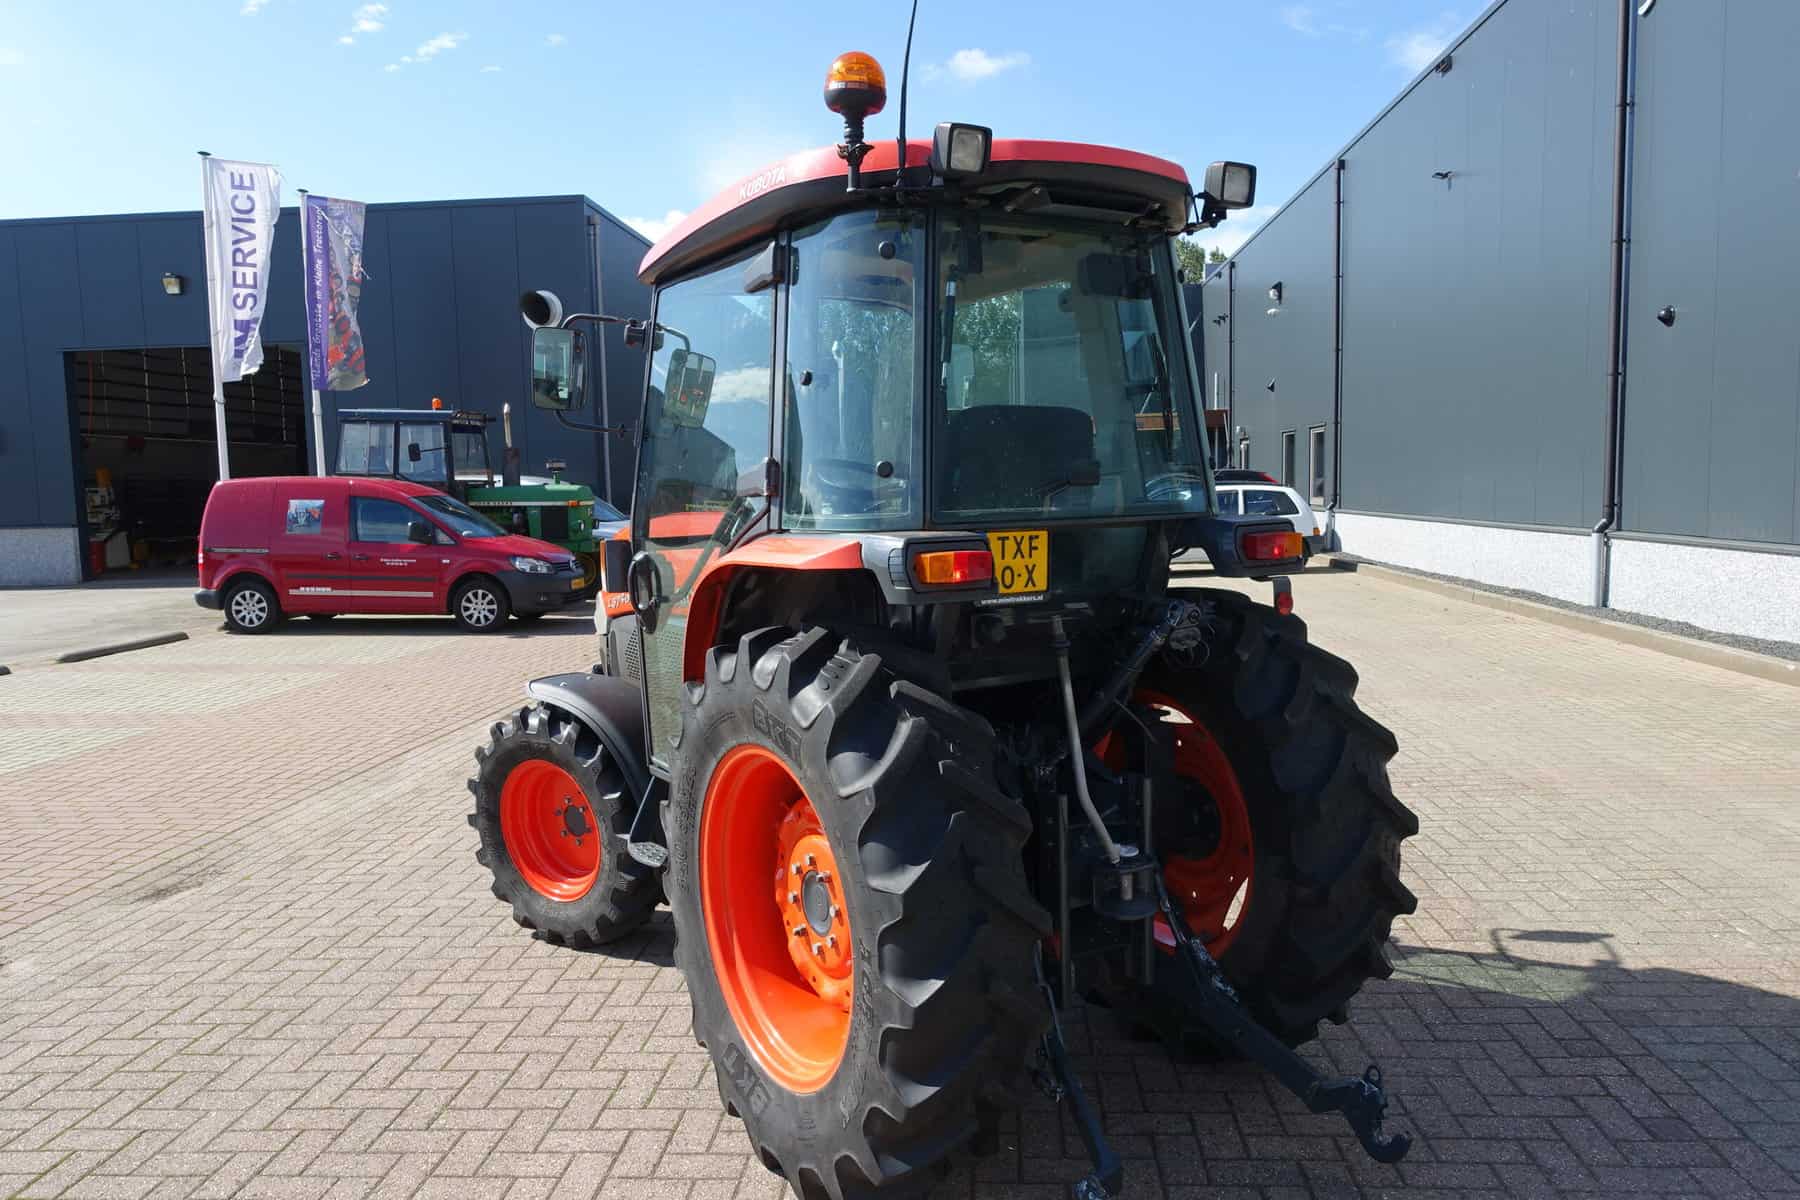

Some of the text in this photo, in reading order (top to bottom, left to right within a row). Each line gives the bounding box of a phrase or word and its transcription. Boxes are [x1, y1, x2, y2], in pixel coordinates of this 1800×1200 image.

[739, 166, 785, 199] KUBOTA
[230, 171, 258, 311] SERVICE
[997, 535, 1040, 560] TXF
[752, 697, 802, 764] BKT
[721, 1042, 773, 1115] BKT
